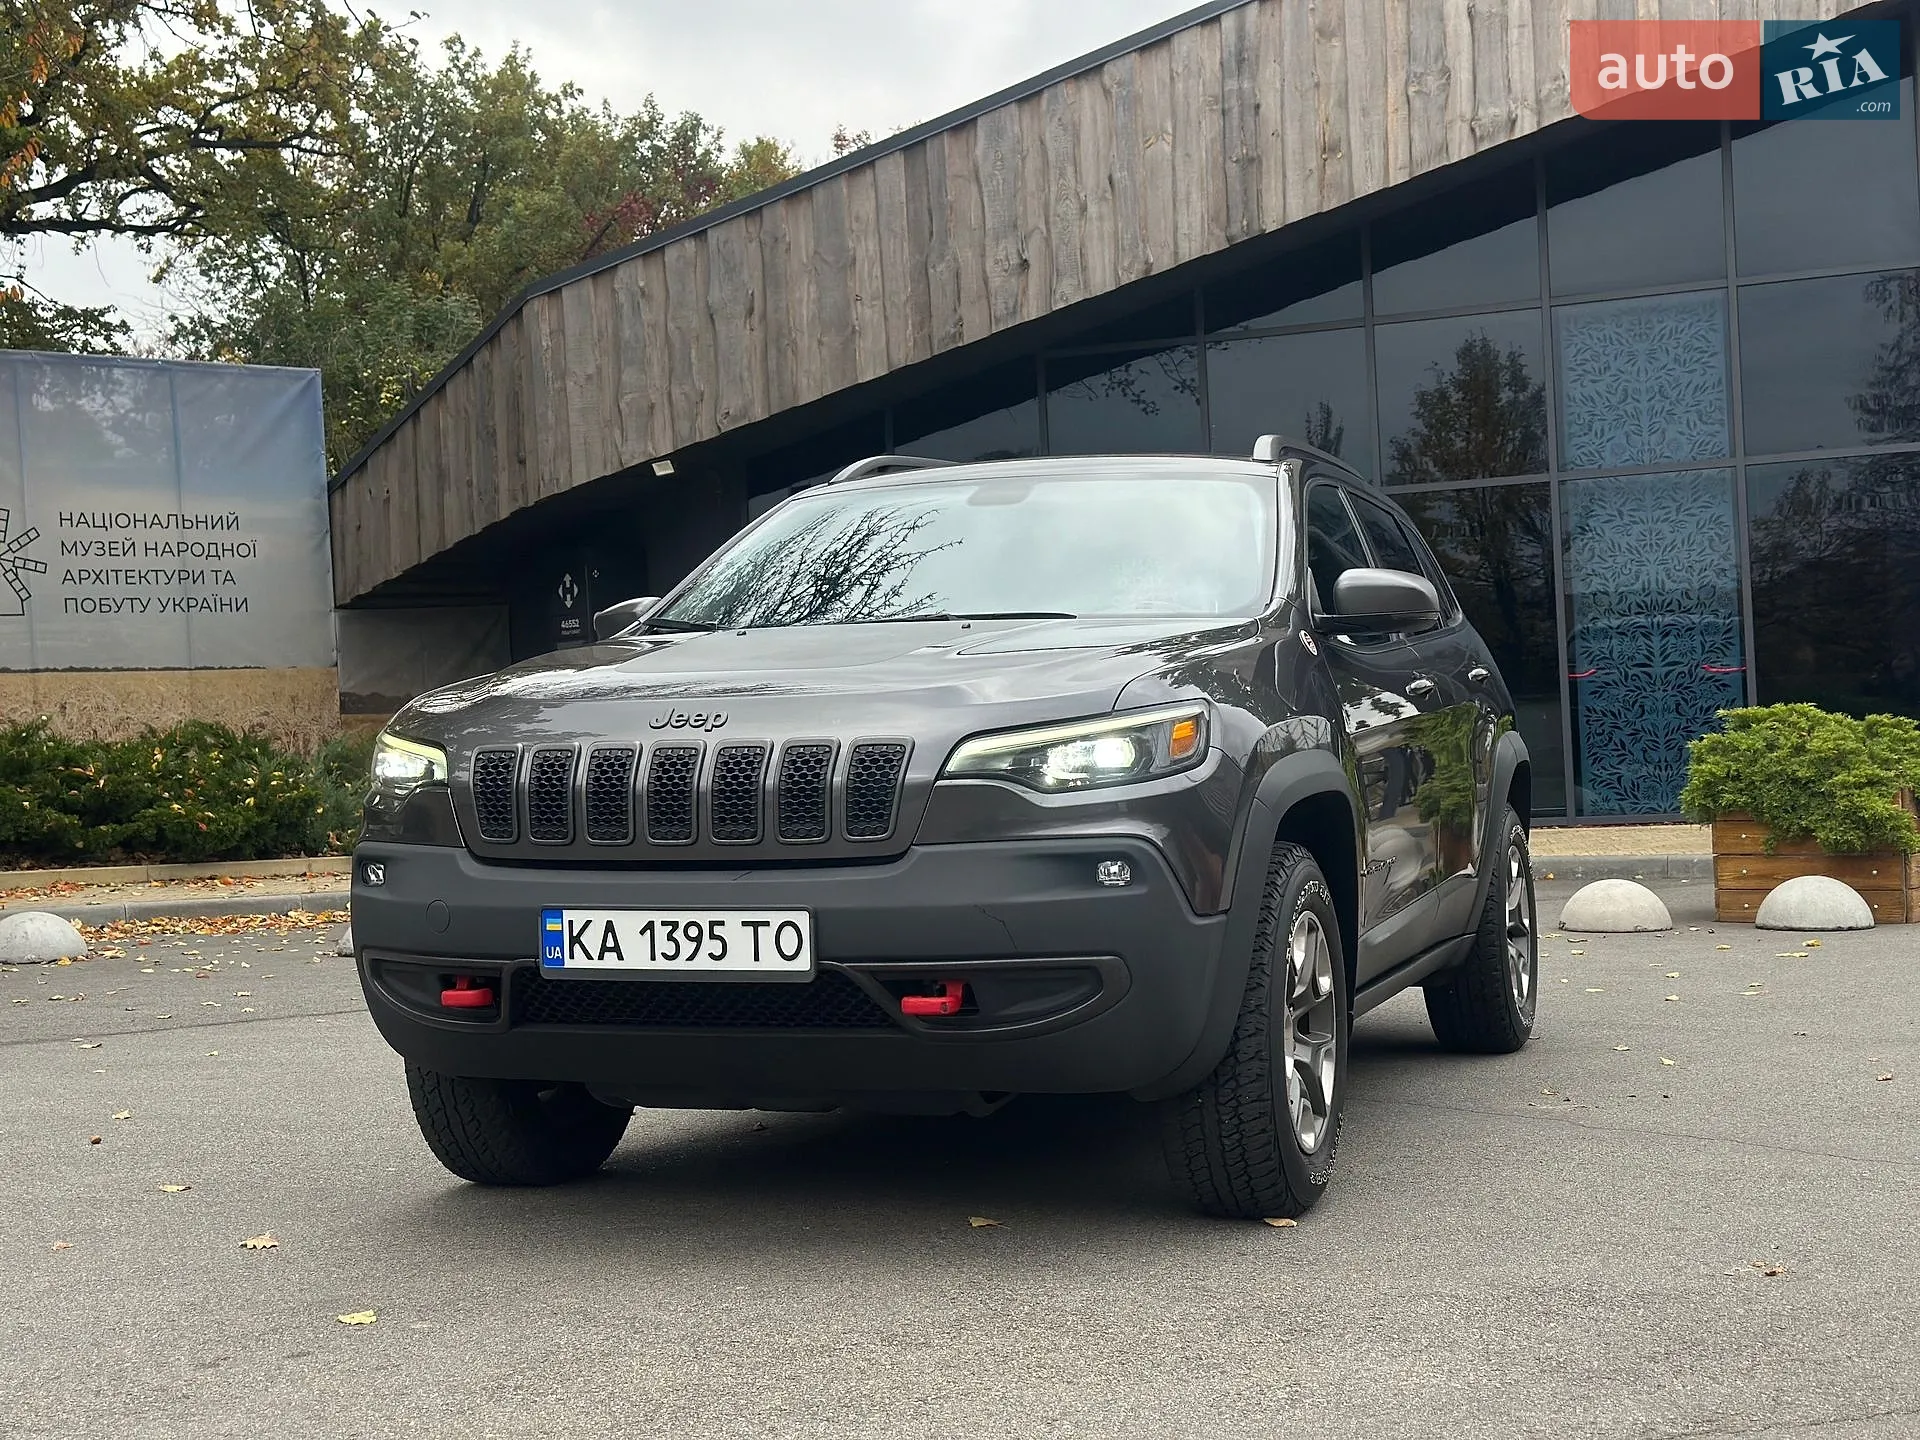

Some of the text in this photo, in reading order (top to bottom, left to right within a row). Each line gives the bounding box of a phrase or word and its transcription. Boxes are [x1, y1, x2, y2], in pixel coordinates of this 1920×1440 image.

[59, 511, 240, 532] НАЦІОНАЛЬНИЙ
[61, 538, 258, 561] МУЗЕЙ НАРОДНОЇ
[61, 569, 236, 586] АРХІТЕКТУРИ ТА
[64, 595, 249, 614] ПОБУТУ УКРАЇНИ
[649, 707, 728, 732] Jeep
[567, 919, 803, 962] KA 1395 TO
[546, 946, 562, 960] UA
